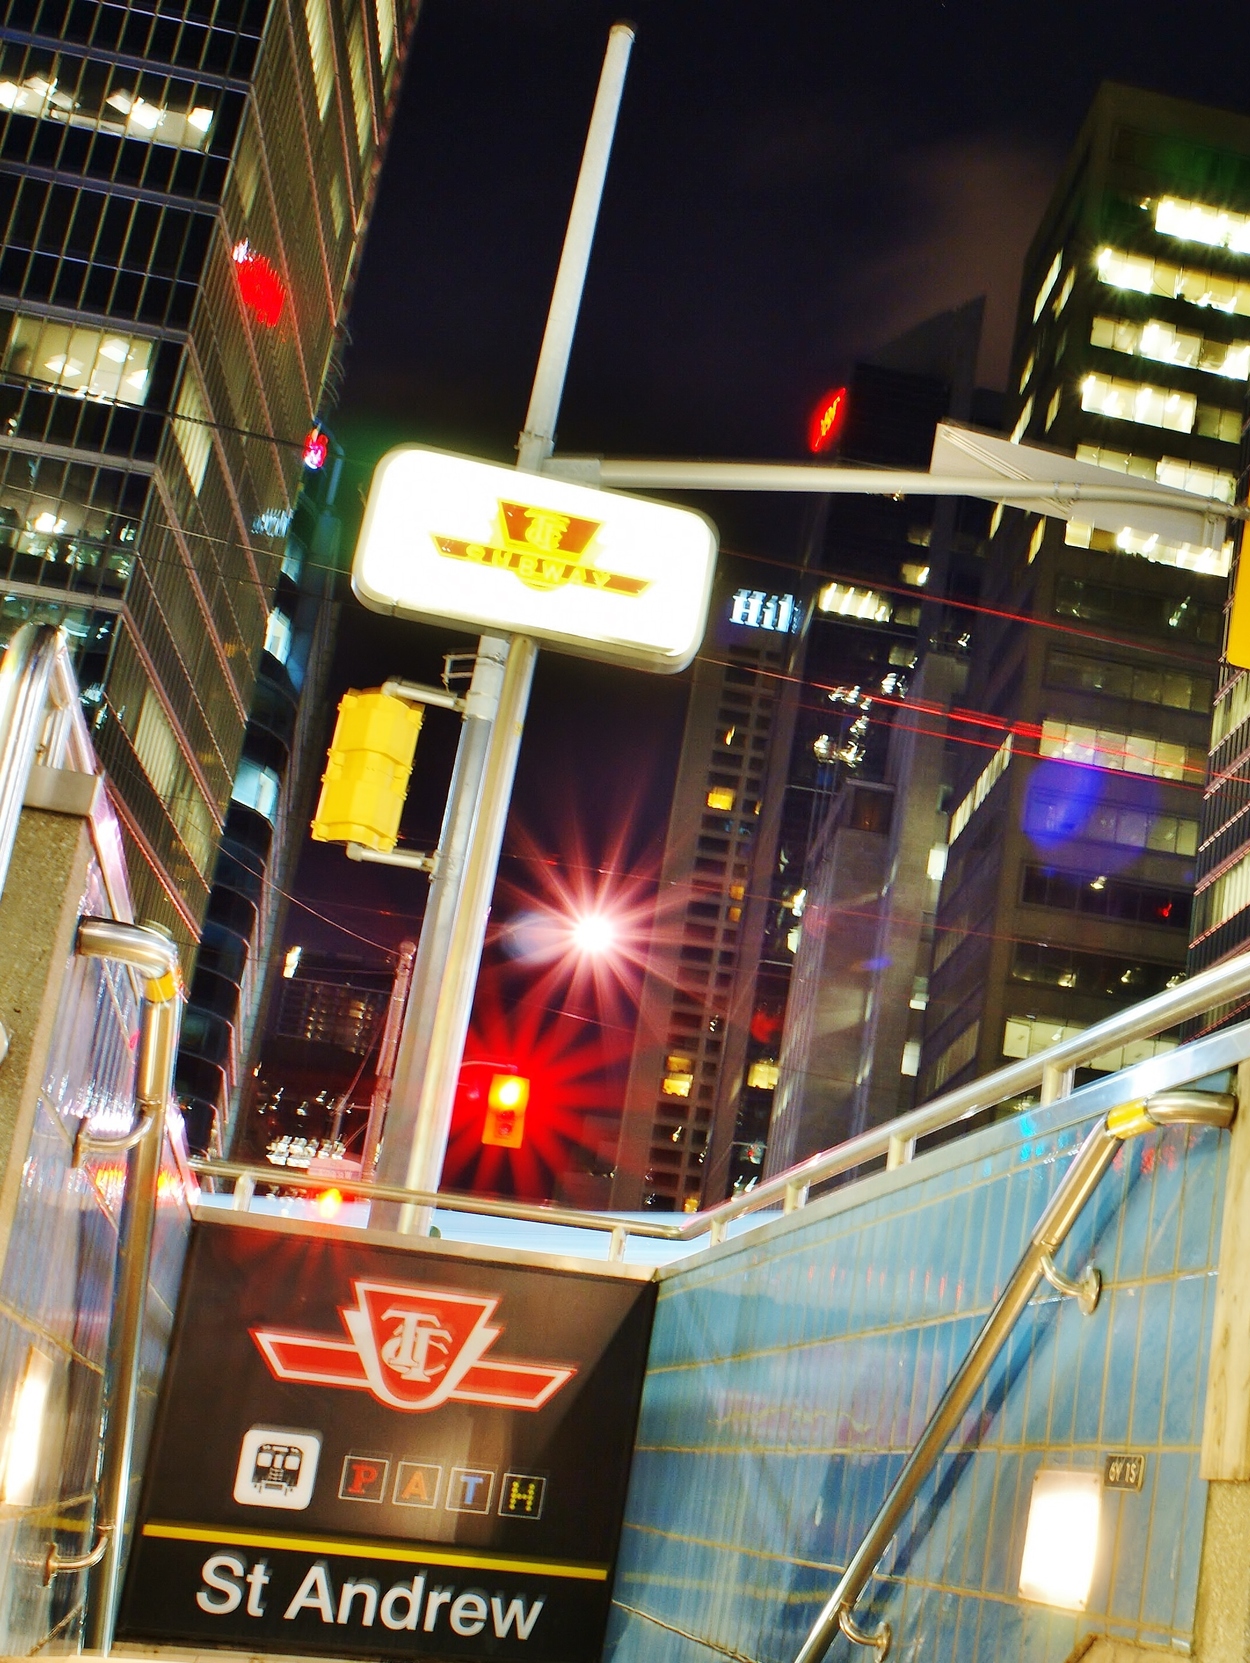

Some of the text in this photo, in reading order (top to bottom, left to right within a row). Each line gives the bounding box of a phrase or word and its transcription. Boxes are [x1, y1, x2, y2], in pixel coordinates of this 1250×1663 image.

[465, 543, 611, 586] SUBWAY
[380, 1308, 453, 1383] TTC
[346, 1460, 535, 1513] PATH
[196, 1555, 544, 1641] St Andrew
